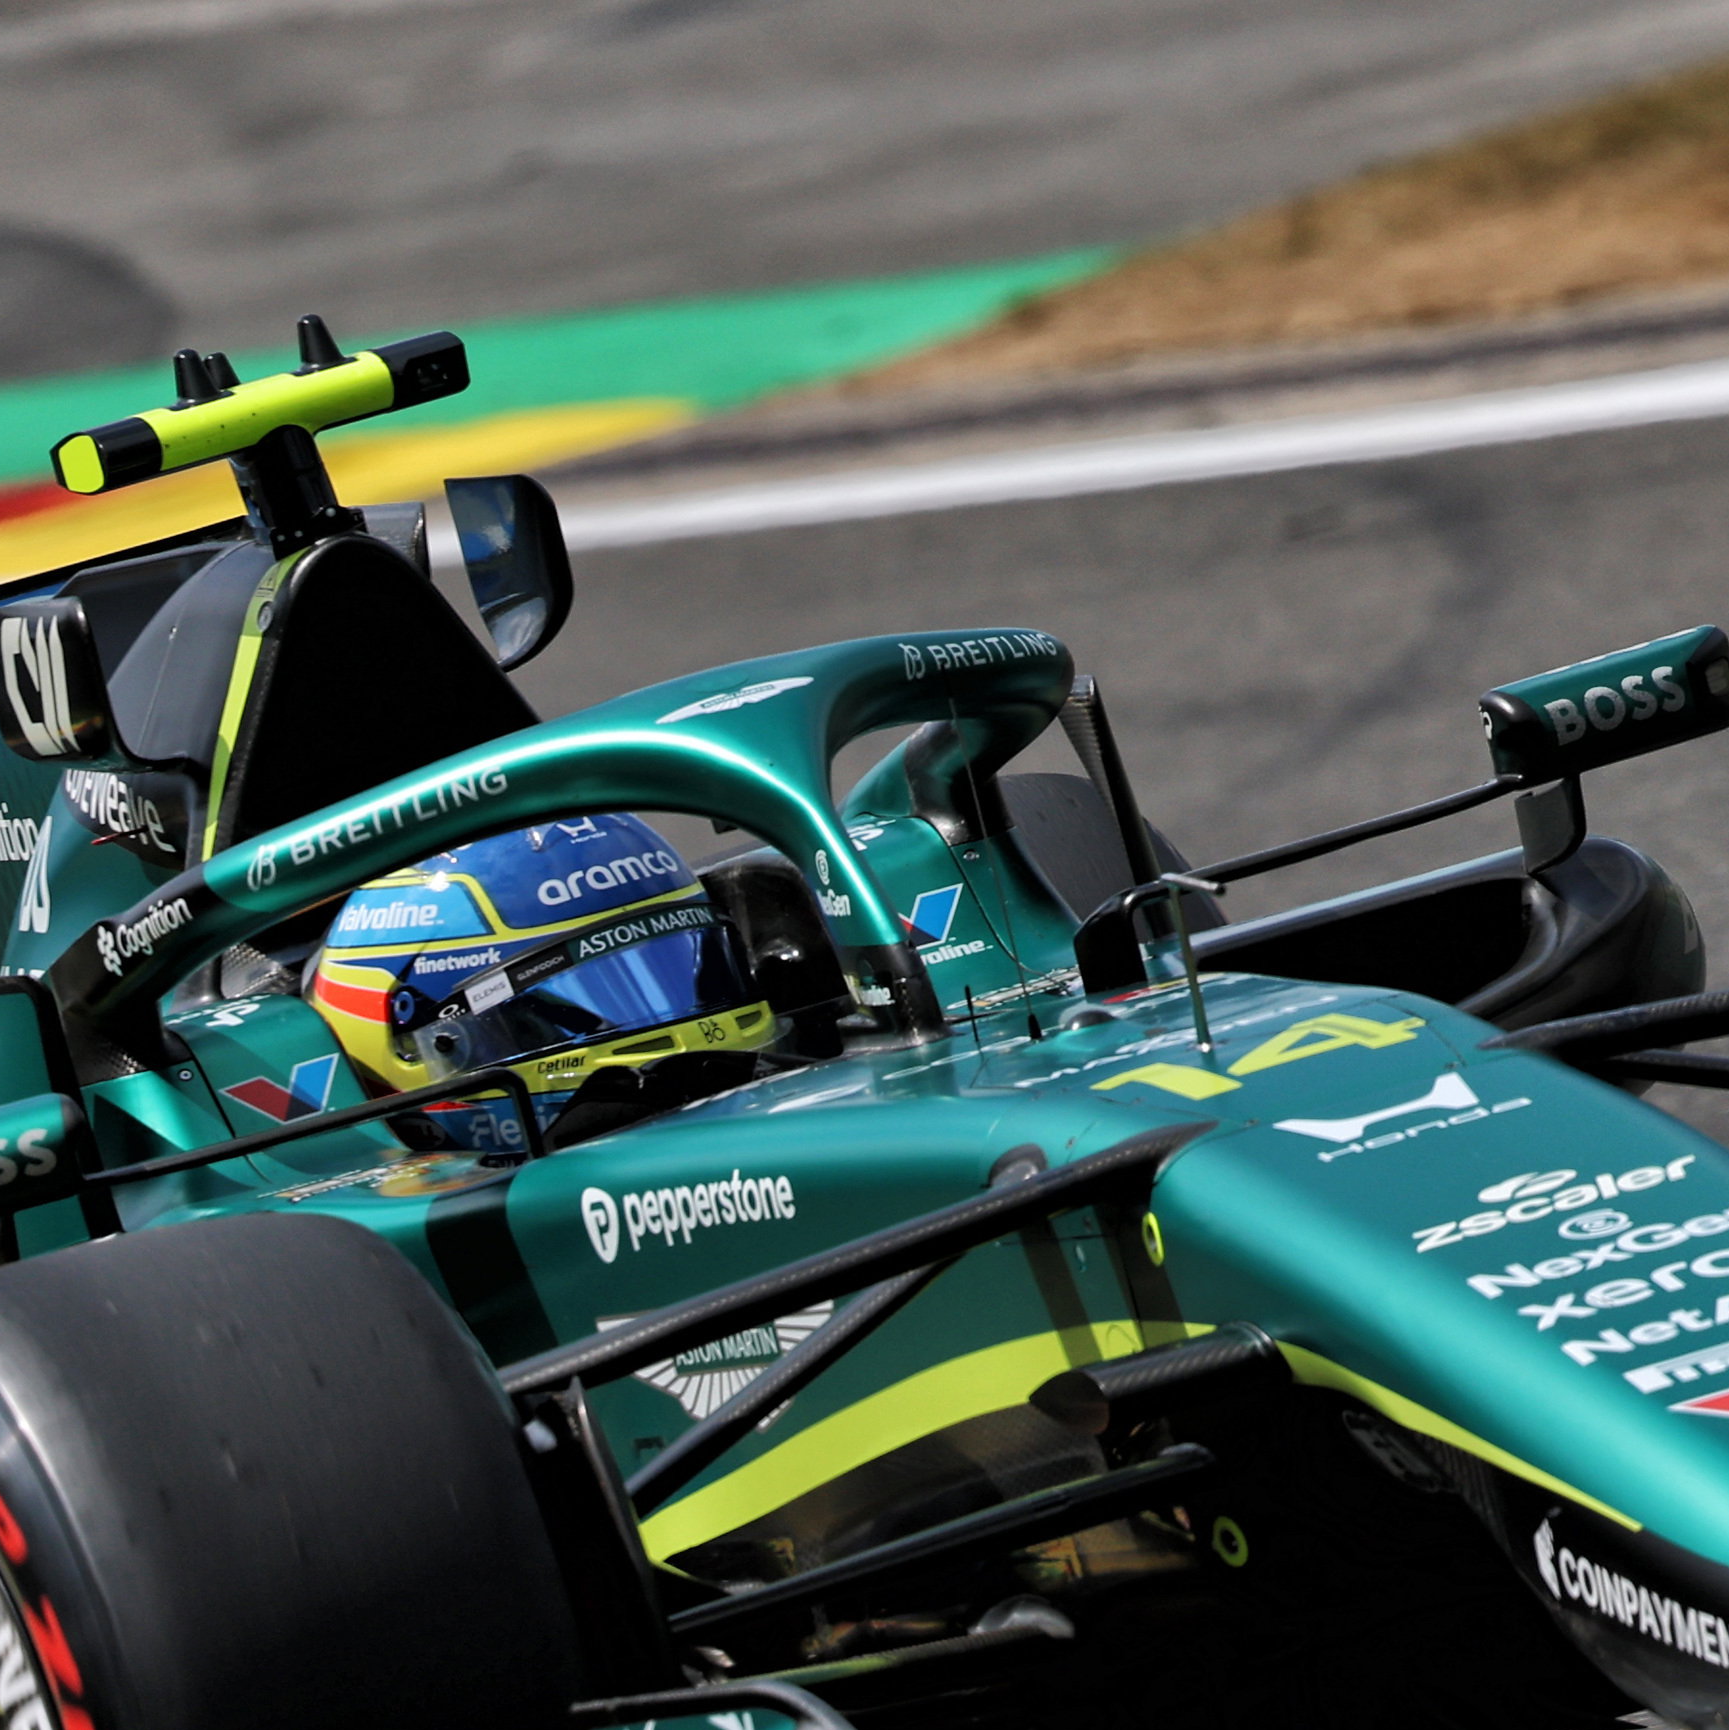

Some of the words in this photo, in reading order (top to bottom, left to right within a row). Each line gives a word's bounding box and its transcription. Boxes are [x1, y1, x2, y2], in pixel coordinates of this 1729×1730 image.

[927, 632, 1057, 673] BREITLING
[1544, 666, 1686, 746] BOSS
[290, 765, 508, 868] BREITLING
[537, 849, 679, 906] aramco
[116, 898, 193, 958] Cognition
[578, 921, 651, 958] ASTON
[651, 906, 714, 935] MARTIN
[413, 947, 502, 975] finetwork
[537, 1055, 587, 1075] Cetilar
[1086, 1013, 1426, 1101] 14
[624, 1168, 796, 1252] pepperstone
[1411, 1154, 1697, 1253] zscaler
[722, 1326, 778, 1360] MARTIN
